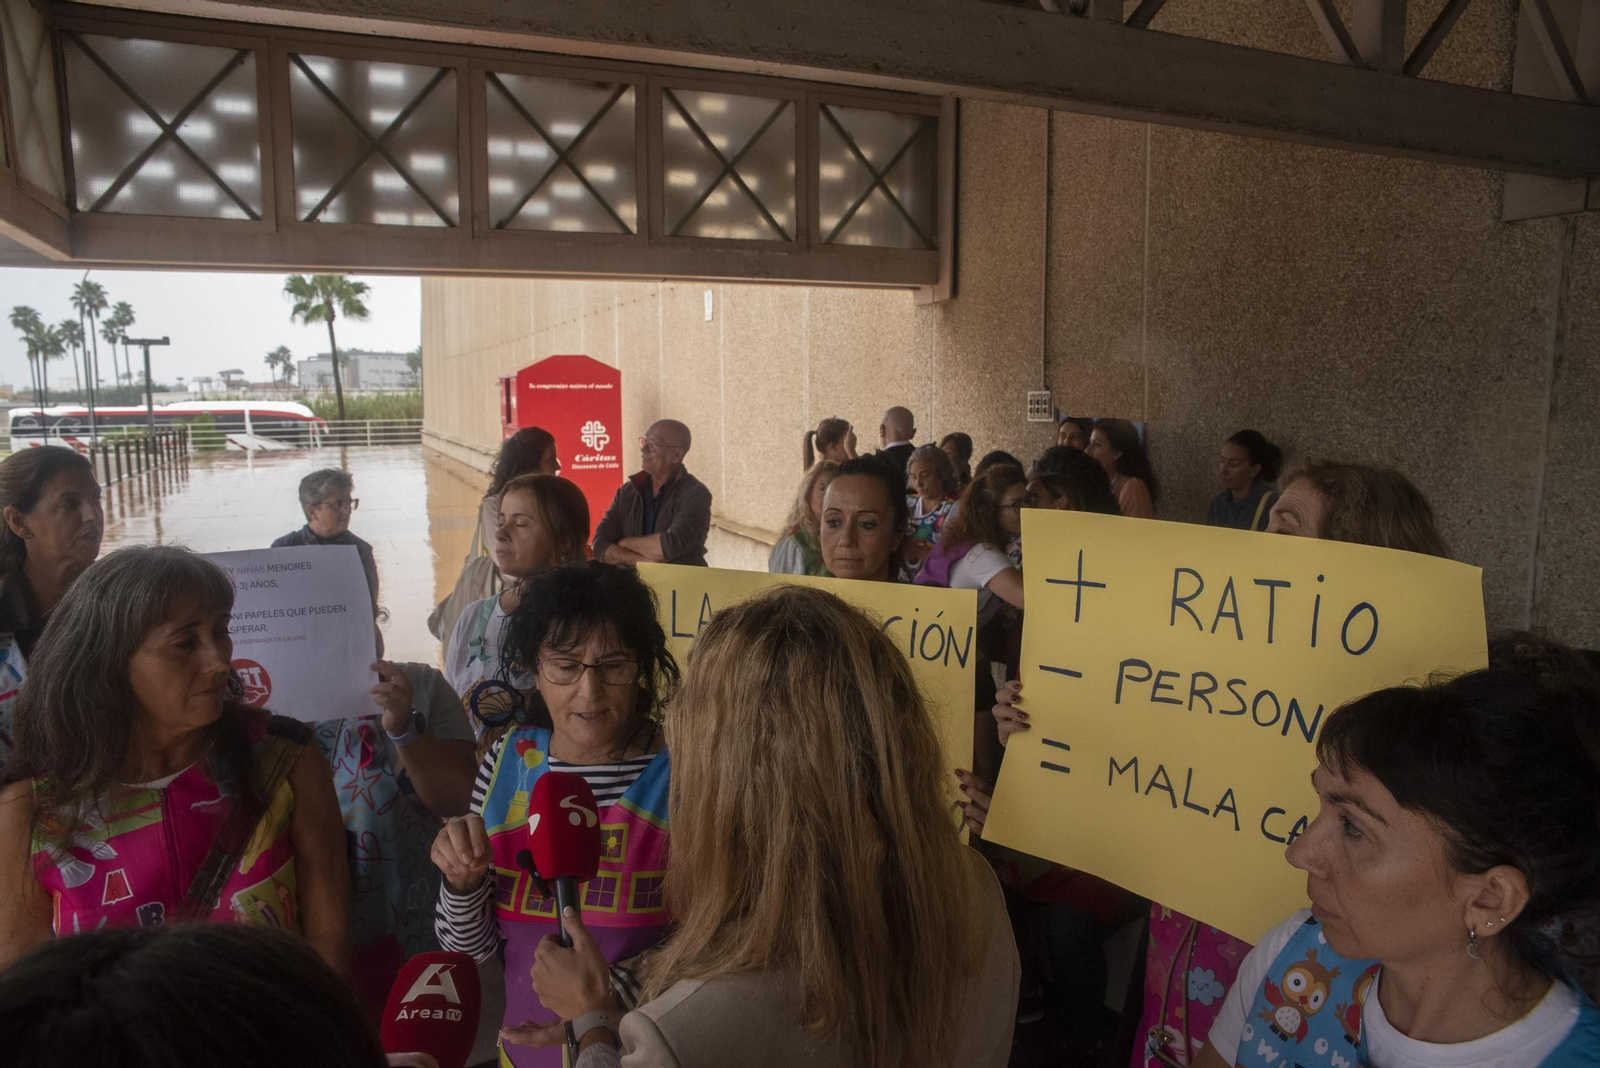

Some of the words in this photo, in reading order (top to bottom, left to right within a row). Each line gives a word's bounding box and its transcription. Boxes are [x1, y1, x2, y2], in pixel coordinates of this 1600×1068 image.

[574, 453, 616, 462] Cáritas
[236, 565, 266, 574] NIÑAS
[267, 561, 312, 573] MENORES
[250, 578, 279, 589] AÑOS,
[245, 608, 285, 620] PAPELES
[286, 607, 307, 618] QUE
[308, 604, 347, 616] PUEDEN
[228, 624, 269, 636] SPERAR.
[240, 636, 273, 645] ENSEÑANZA
[1115, 658, 1324, 743] PERSON
[1108, 756, 1241, 832] MALA
[1260, 806, 1308, 846] CA
